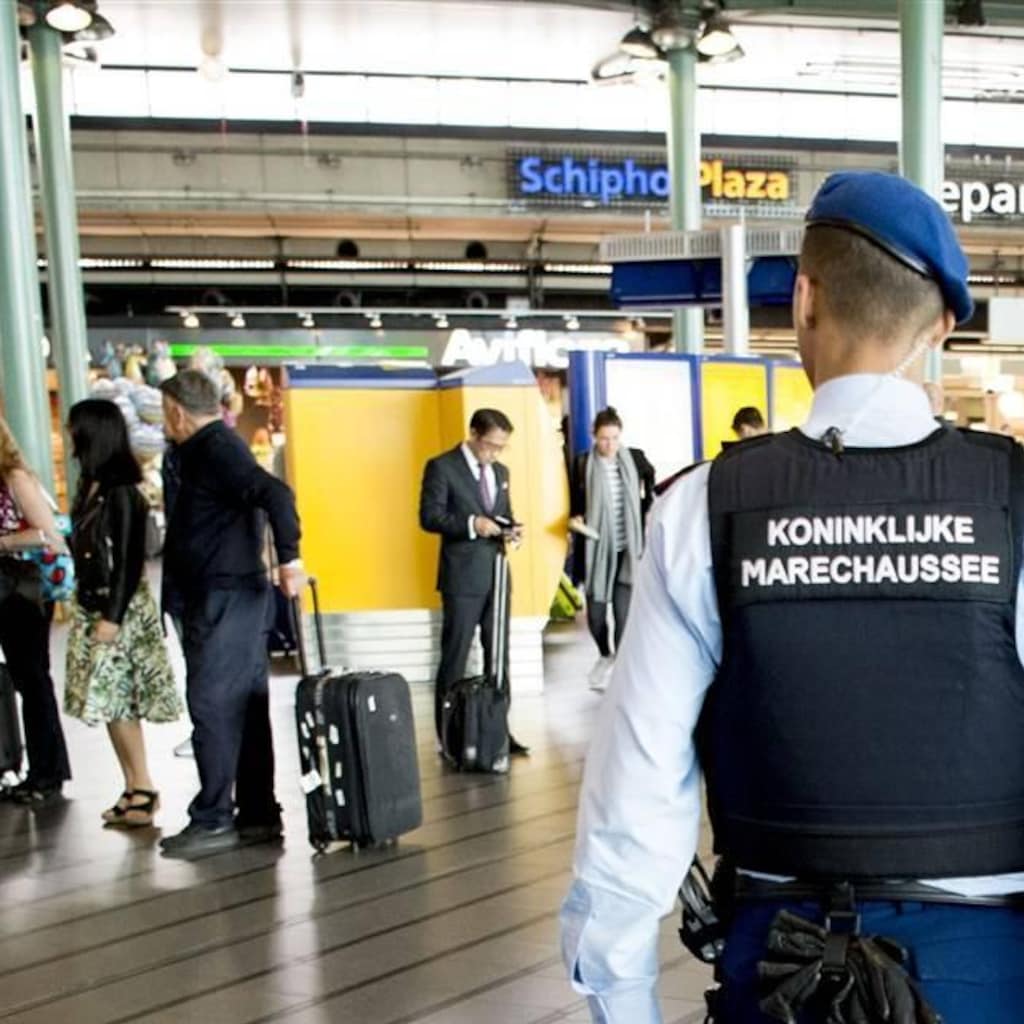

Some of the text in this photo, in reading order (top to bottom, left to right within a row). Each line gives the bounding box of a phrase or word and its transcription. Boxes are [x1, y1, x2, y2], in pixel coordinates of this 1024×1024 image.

[519, 156, 671, 203] Schipho
[767, 515, 975, 546] KONINKLIJKE
[741, 555, 1000, 587] MARECHAUSSEE
